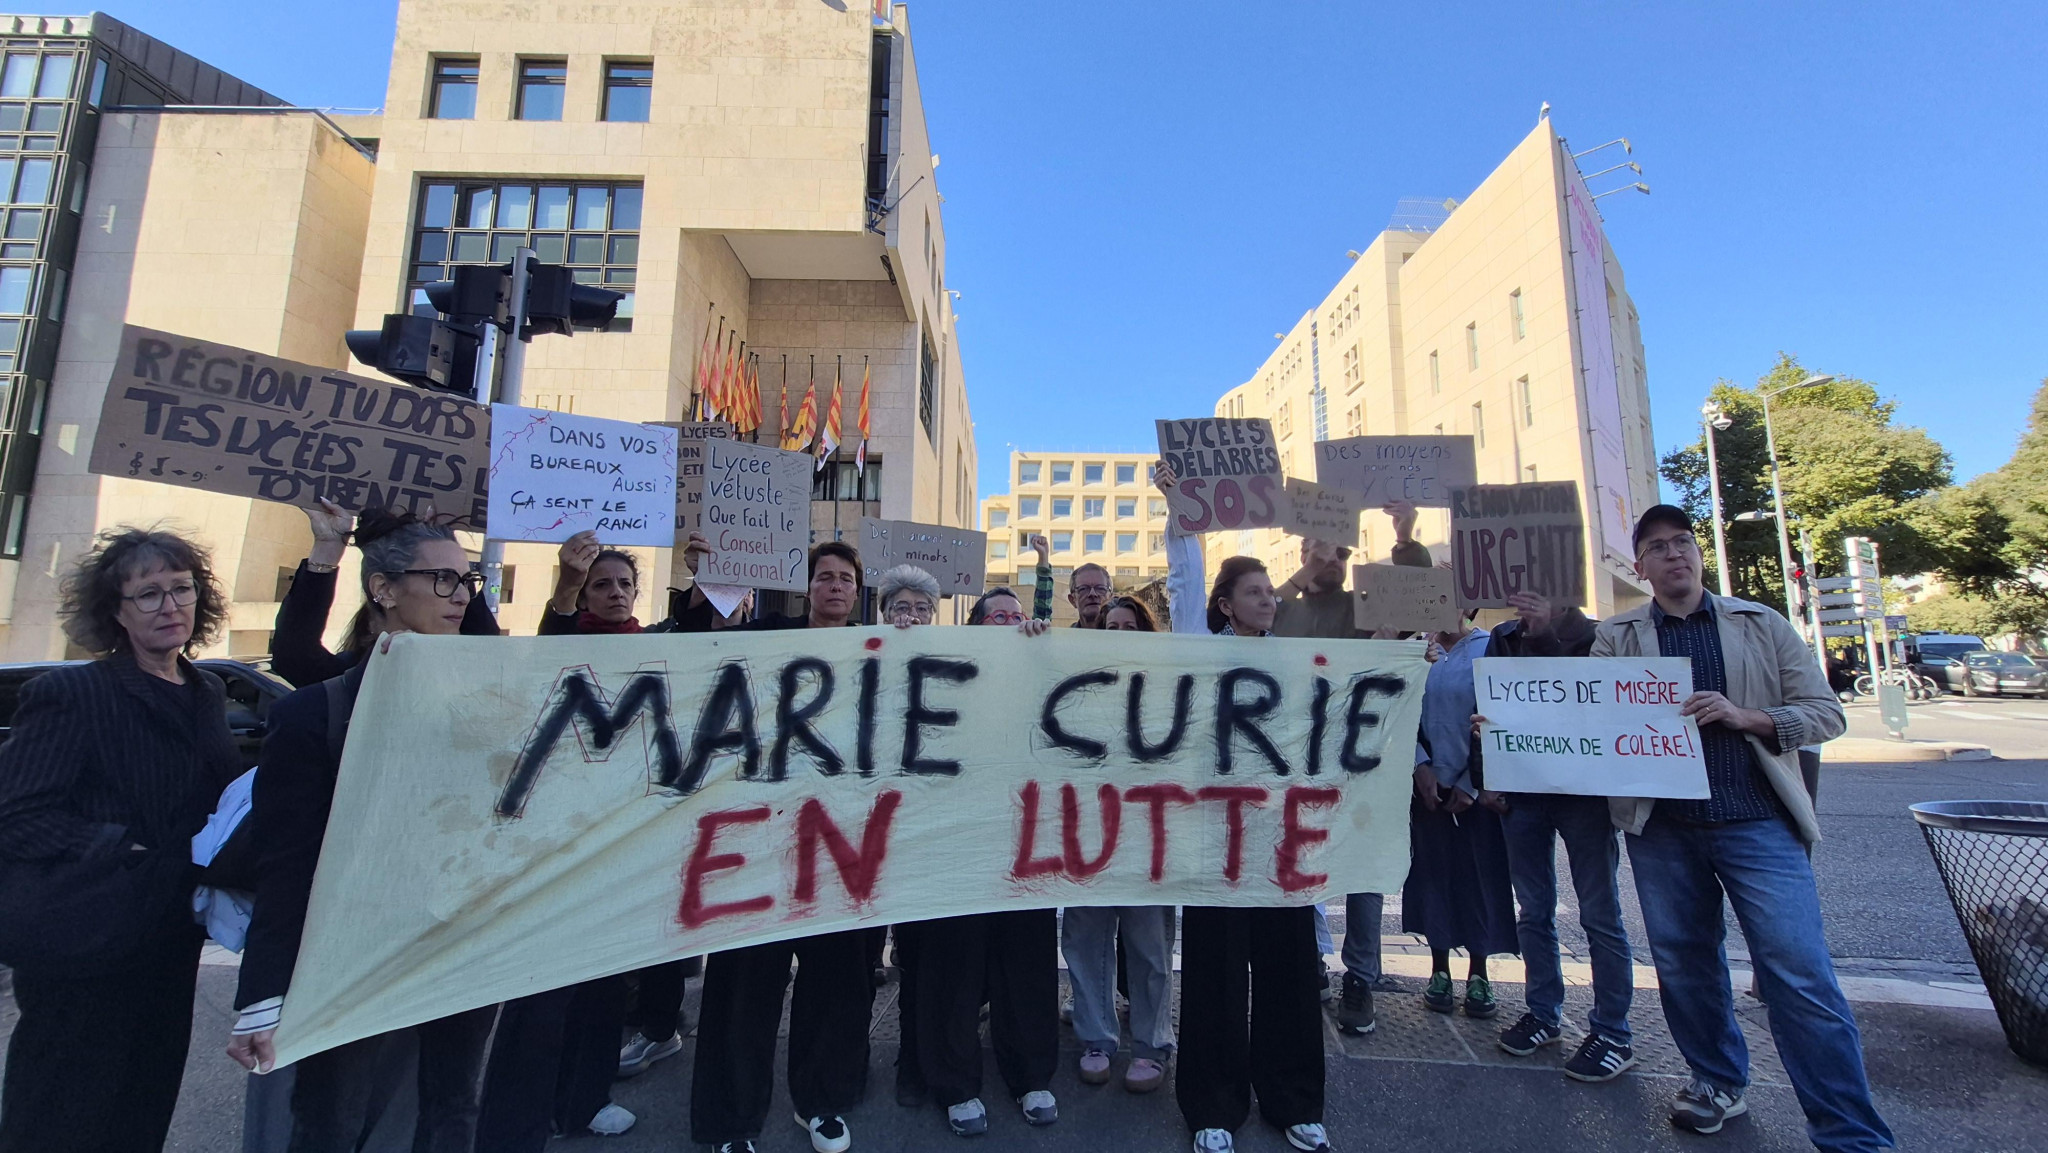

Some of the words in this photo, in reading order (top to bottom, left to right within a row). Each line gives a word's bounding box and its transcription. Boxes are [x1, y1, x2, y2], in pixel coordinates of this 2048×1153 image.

[321, 376, 379, 421] TU
[378, 386, 477, 440] DORS
[124, 386, 225, 448] TES
[383, 437, 467, 491] TES
[550, 426, 606, 449] DANS
[620, 436, 658, 454] VOS
[681, 423, 727, 439] LYCÉES
[530, 454, 624, 475] BUREAUX
[712, 446, 771, 481] Lycée
[1324, 443, 1362, 462] Des
[1376, 443, 1452, 465] moyens
[1364, 463, 1390, 473] pour
[1400, 463, 1421, 472] nos
[248, 466, 434, 515] TOMBENT
[511, 491, 536, 515] ÇA
[543, 498, 594, 509] SENT
[601, 501, 627, 512] LE
[1178, 475, 1276, 532] SOS
[595, 515, 648, 531] RANCI
[709, 505, 736, 525] Que
[781, 512, 794, 532] le
[869, 522, 889, 540] De
[720, 529, 774, 555] Conseil
[905, 548, 948, 563] minots
[954, 572, 971, 586] JO
[1488, 675, 1567, 703] LYCEES
[1576, 680, 1602, 704] DE
[1615, 669, 1681, 705] MISÈRE
[494, 637, 979, 819] MARIE
[1040, 654, 1407, 777] CURIE
[1490, 729, 1575, 754] TERREAUX
[1580, 738, 1603, 756] DE
[1615, 723, 1696, 759] COLÈRE!
[679, 790, 903, 929] EN
[1010, 779, 1341, 893] LUTTE
